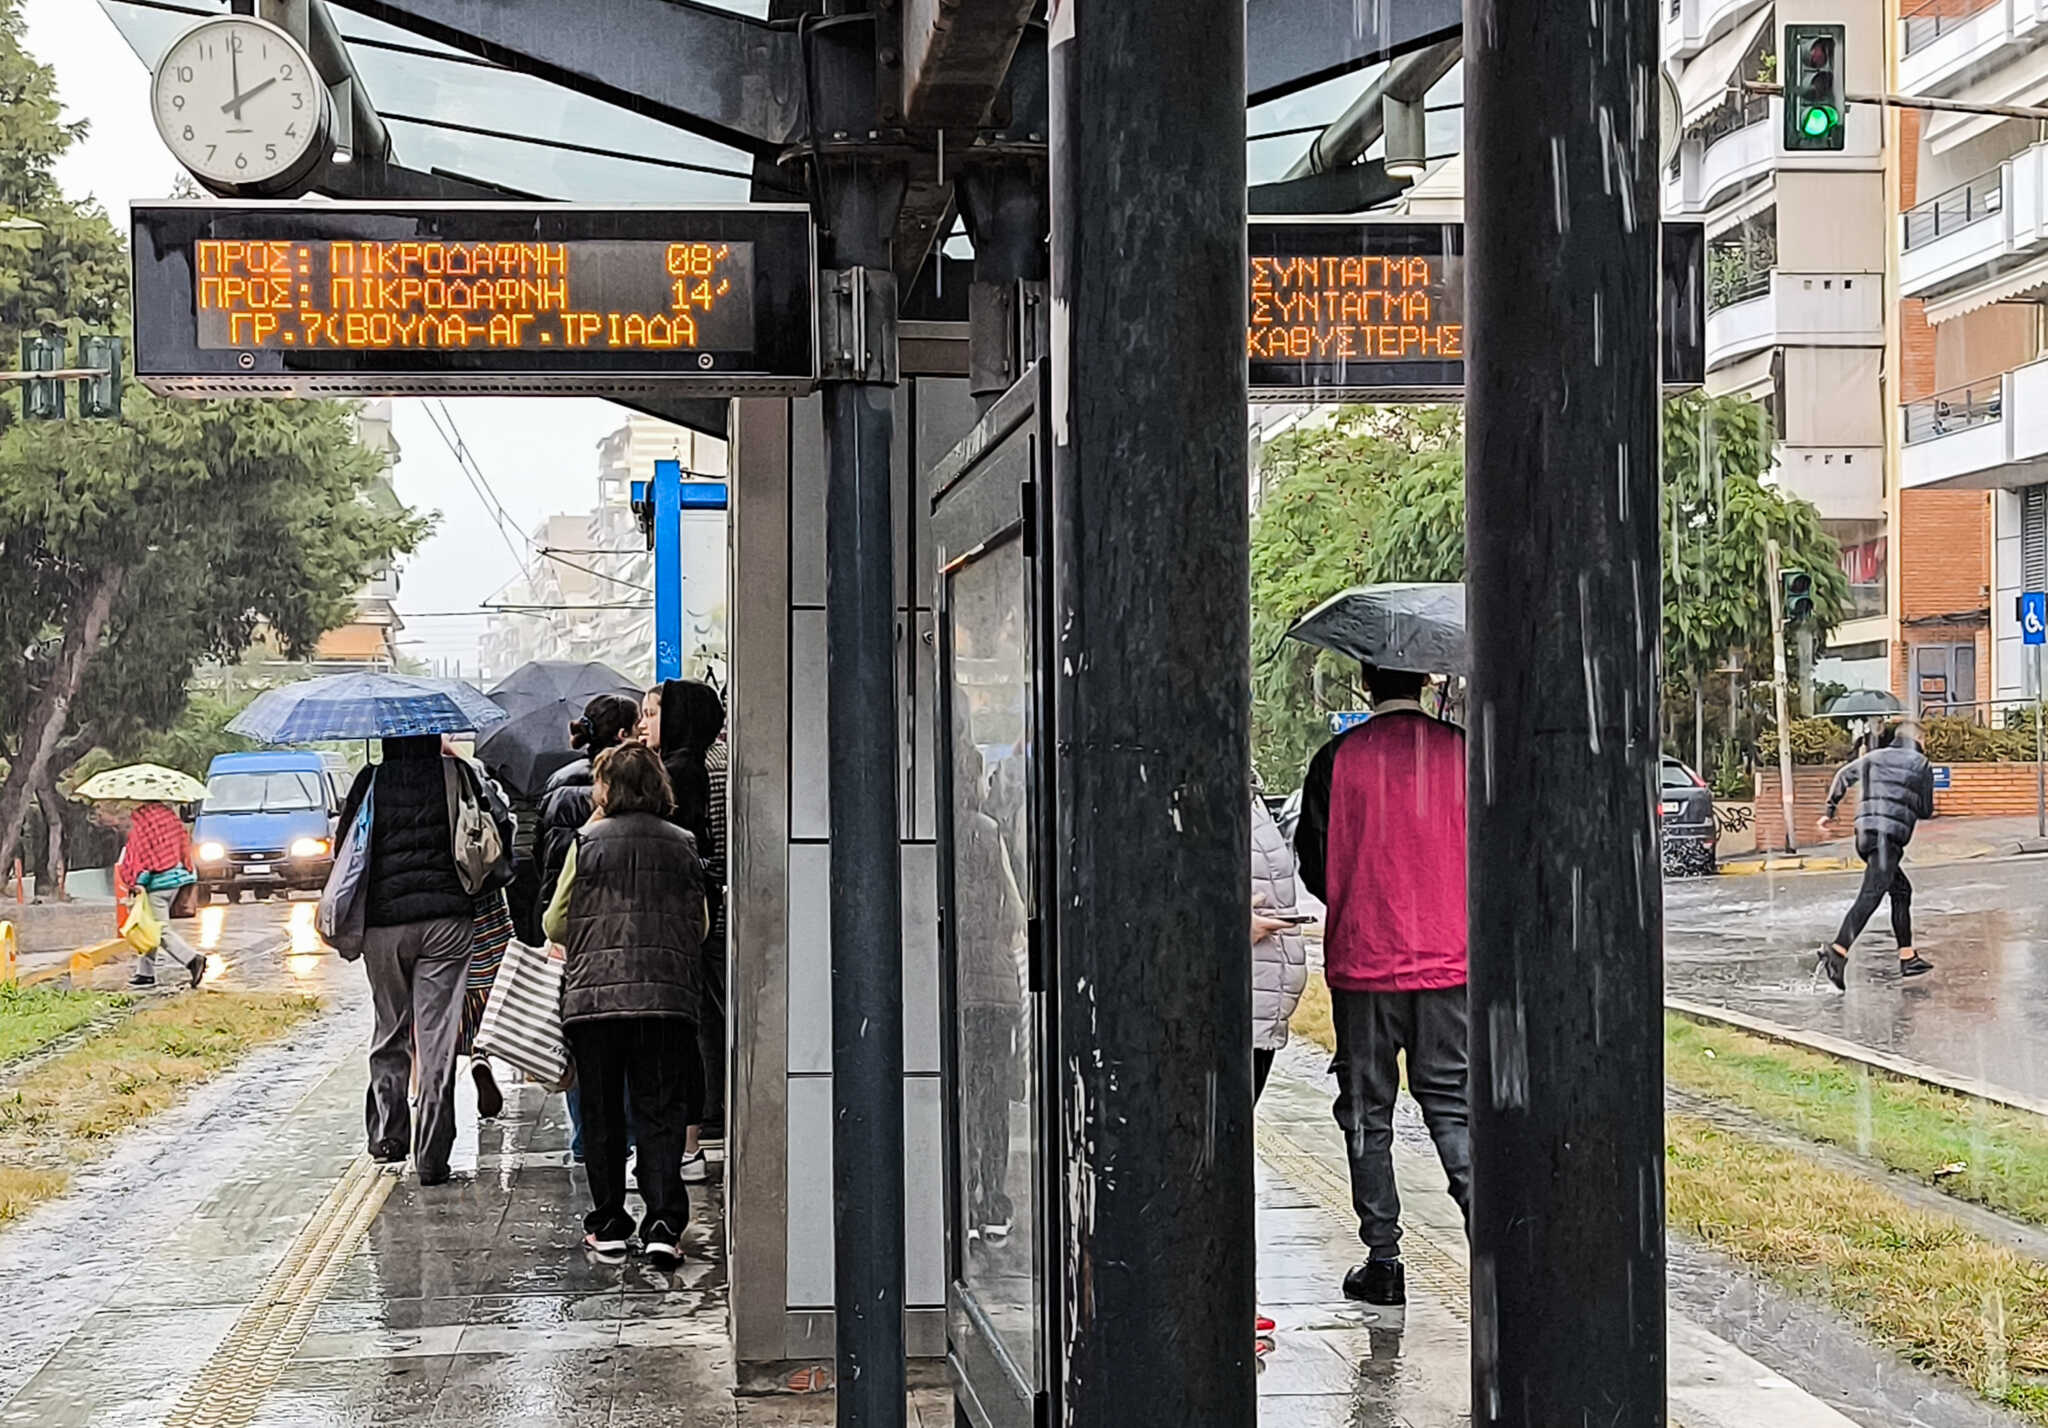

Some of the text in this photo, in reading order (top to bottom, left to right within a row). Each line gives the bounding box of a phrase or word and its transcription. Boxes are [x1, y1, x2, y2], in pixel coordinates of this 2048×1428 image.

[199, 41, 213, 61] 11
[225, 35, 243, 54] 12
[176, 66, 194, 83] 10
[279, 64, 293, 82] 2
[172, 95, 186, 112] 9
[291, 92, 304, 110] 3
[182, 124, 195, 142] 8
[284, 121, 297, 140] 4
[205, 144, 218, 162] 7
[234, 152, 248, 170] 6
[265, 144, 278, 161] 5
[199, 241, 309, 274] ΠΡΟΣ:
[330, 241, 567, 275] ΠΙΚΡΟΔΑΦΝΗ
[1251, 256, 1430, 288] ΣΥΝΤΑΓΜΑ
[200, 277, 310, 309] ΠΡΟΣ:
[331, 277, 567, 310] ΠΙΚΡΟΔΑΦΝΗ
[1251, 290, 1430, 322] ΣΥΝΤΑΓΜΑ
[1247, 325, 1463, 358] ΚΑΘΥΣΤΕΡΗΣ
